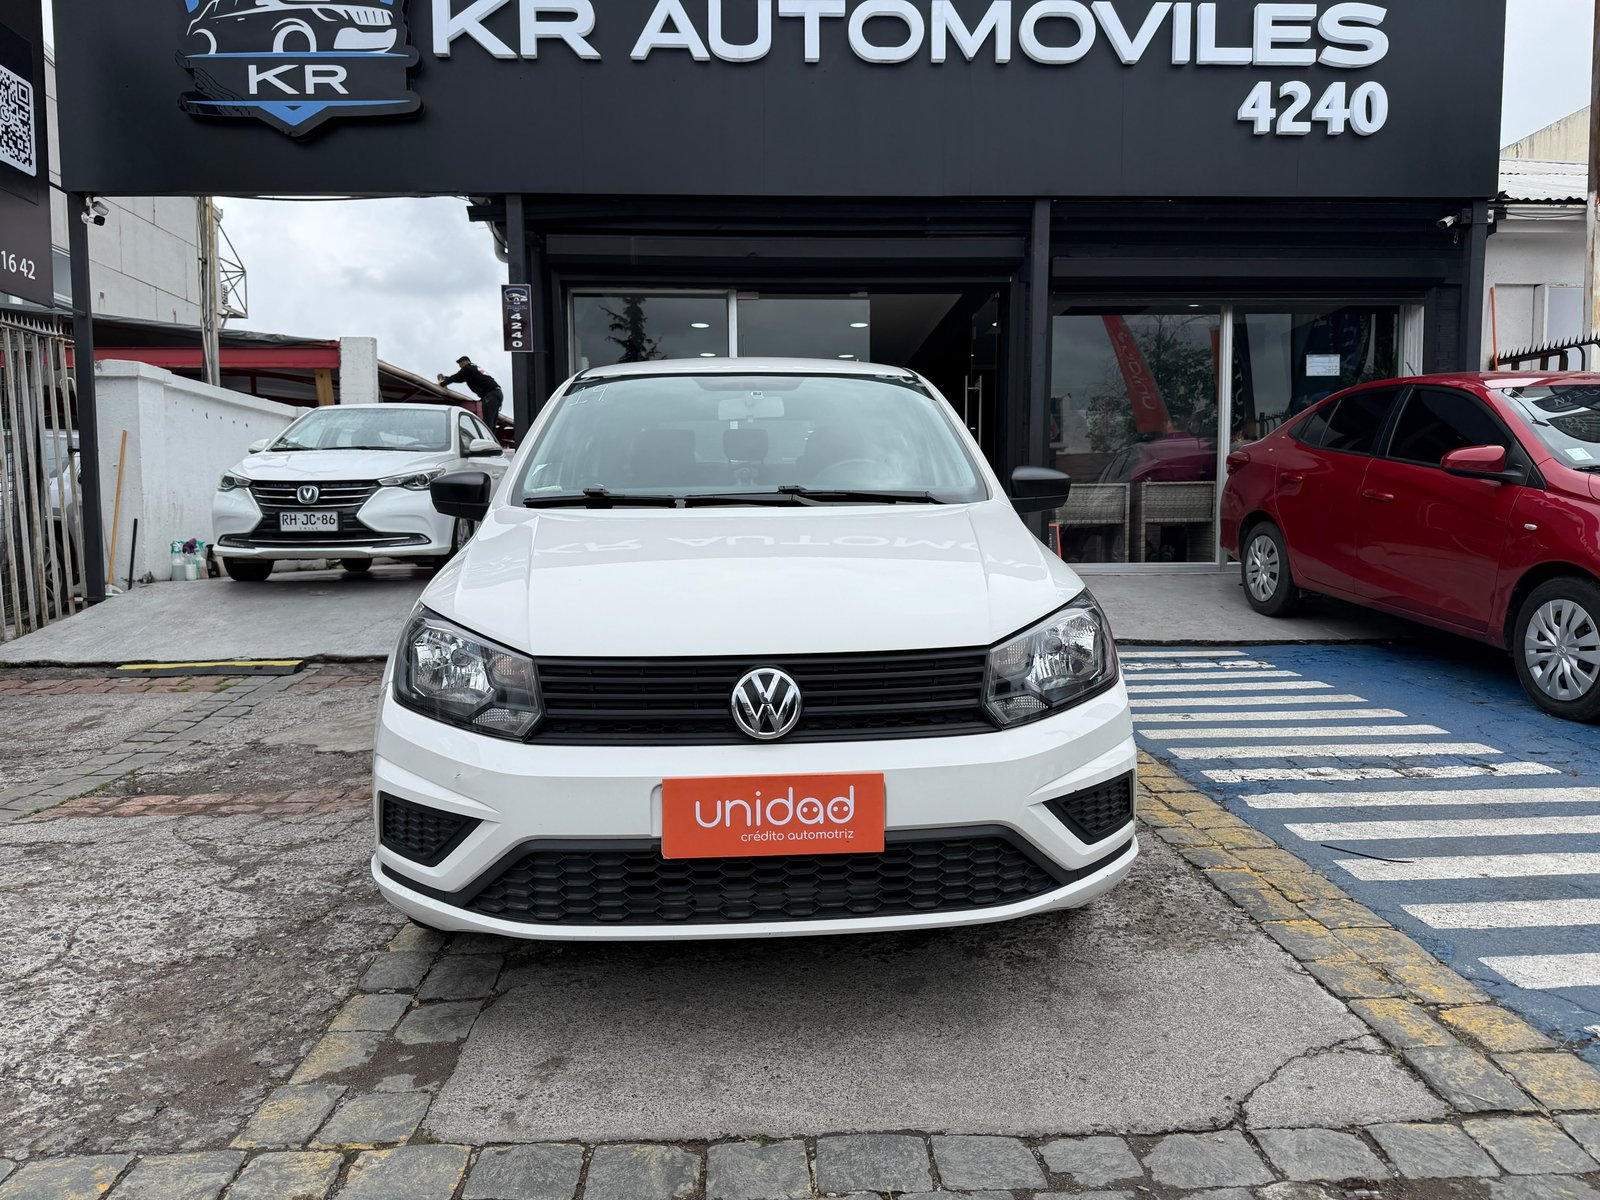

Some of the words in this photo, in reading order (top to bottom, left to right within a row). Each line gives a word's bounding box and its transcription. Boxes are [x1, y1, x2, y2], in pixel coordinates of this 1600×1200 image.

[432, 0, 601, 61] KR
[629, 0, 1389, 68] AUTOMOVILES
[247, 64, 350, 95] KR
[1237, 80, 1389, 136] 4240
[0, 250, 17, 273] 16
[19, 257, 36, 280] 42
[510, 312, 523, 348] 4240
[695, 785, 855, 828] unidad
[740, 830, 785, 842] crédito
[787, 828, 854, 841] automotriz
